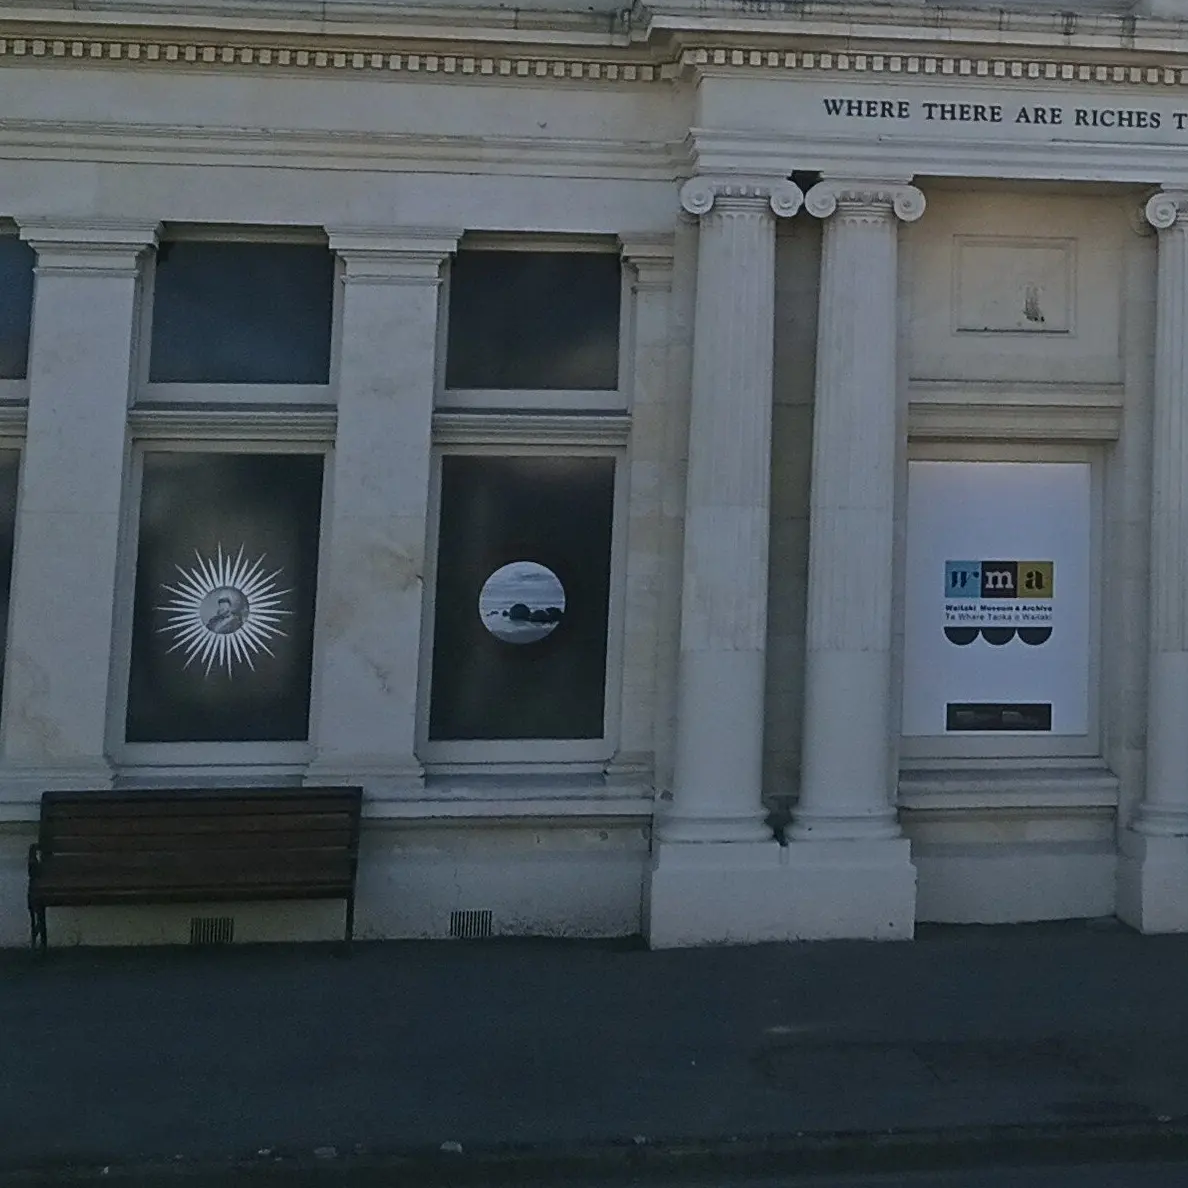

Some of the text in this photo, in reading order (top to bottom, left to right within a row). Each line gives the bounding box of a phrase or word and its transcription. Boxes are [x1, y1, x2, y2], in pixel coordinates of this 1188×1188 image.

[823, 98, 909, 118] WHERE
[921, 102, 1002, 122] THERE
[1015, 106, 1062, 124] ARE
[1074, 108, 1160, 128] RICHES
[980, 604, 1013, 612] Museum
[1022, 604, 1053, 612] Archive
